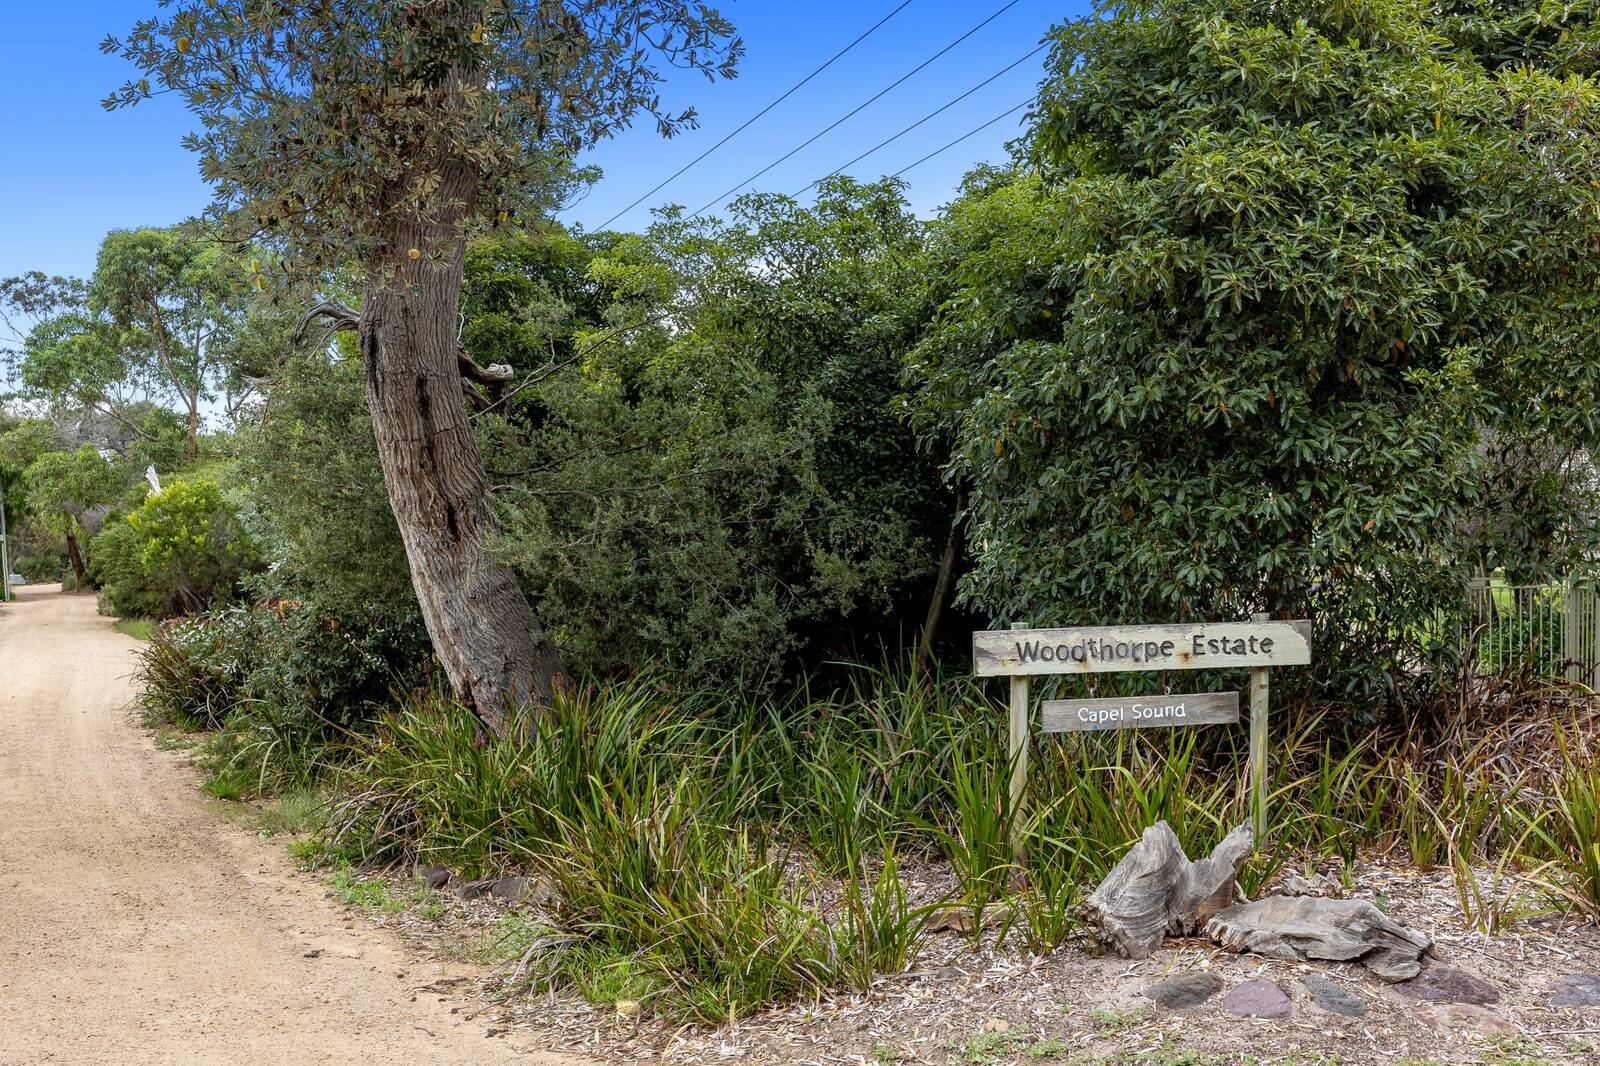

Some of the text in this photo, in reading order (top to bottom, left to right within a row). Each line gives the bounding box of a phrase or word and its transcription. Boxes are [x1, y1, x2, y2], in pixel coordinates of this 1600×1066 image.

[1015, 635, 1274, 663] Woodthorpe Estate
[1077, 703, 1186, 724] Capel Sound
